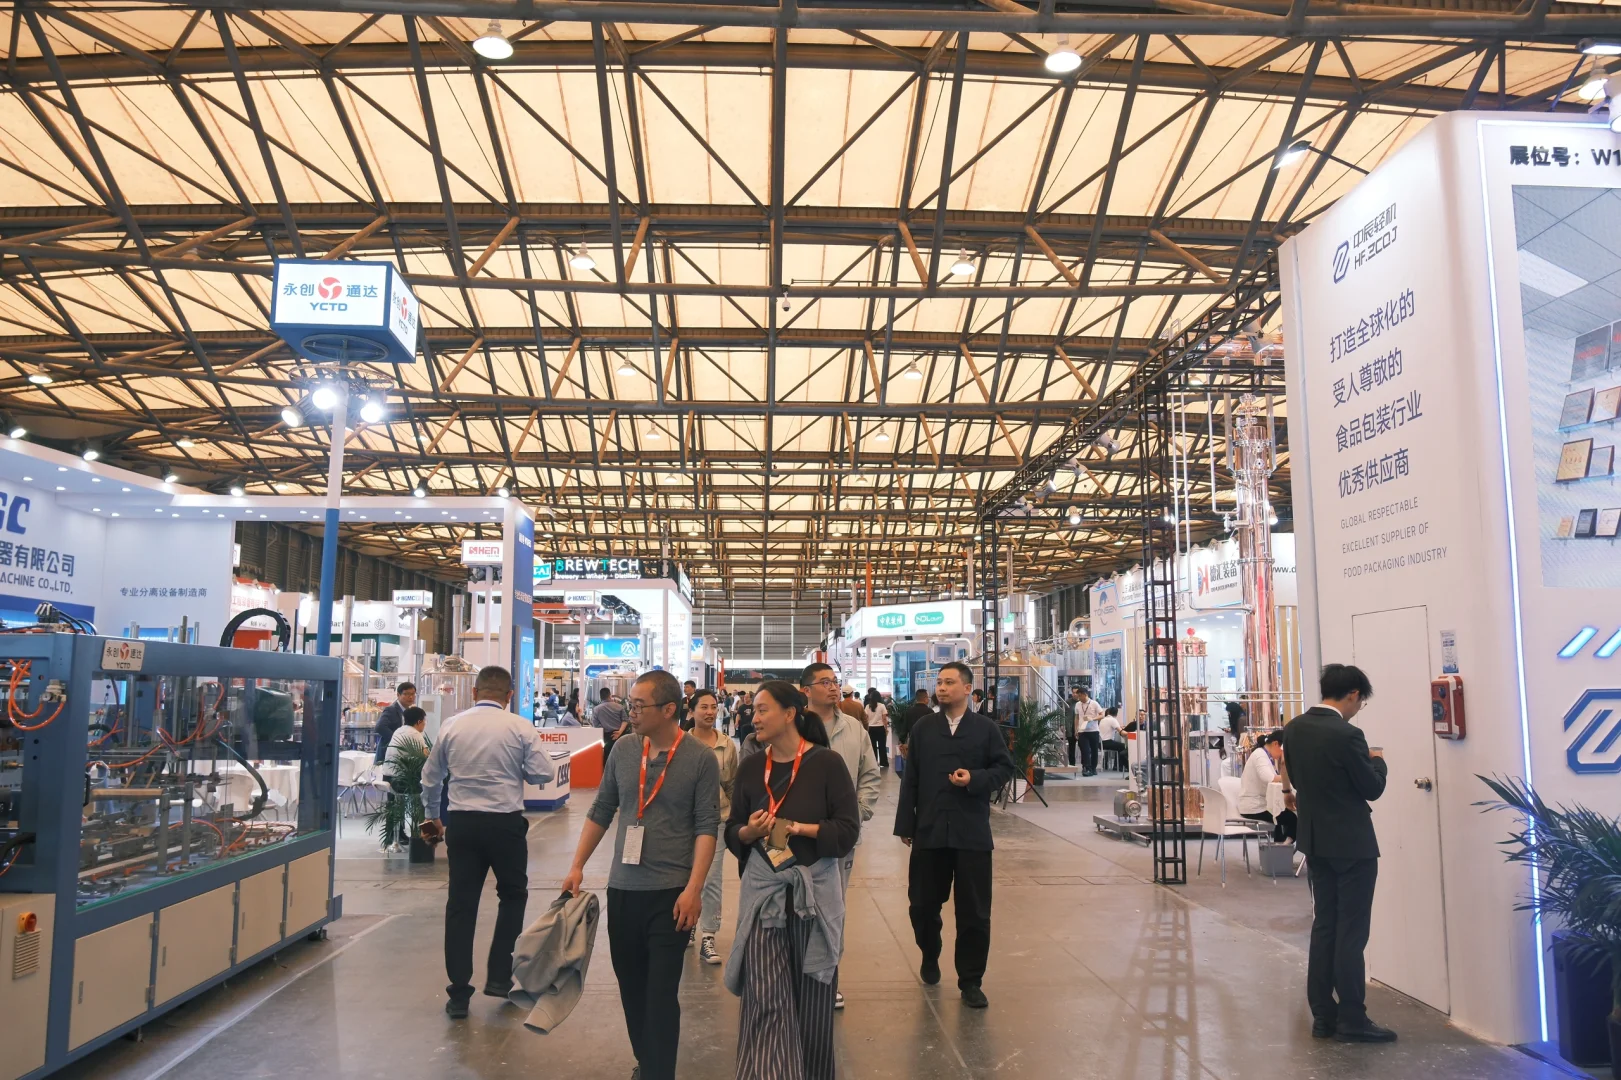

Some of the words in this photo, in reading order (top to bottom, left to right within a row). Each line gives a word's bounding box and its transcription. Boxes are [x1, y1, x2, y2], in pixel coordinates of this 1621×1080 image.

[1354, 203, 1397, 249] 中辰轻机
[309, 302, 348, 311] YCTD
[1330, 288, 1414, 363] 打造全球化的
[1333, 347, 1403, 408] 受人尊敬的
[1336, 389, 1423, 453] 食品包装行业
[1338, 447, 1409, 498] 优秀供应商
[1341, 513, 1366, 529] GLOBAL
[1368, 497, 1419, 521] RESPECTABLE
[1342, 535, 1379, 553] EXCELLENT
[1381, 525, 1416, 544] SUPPLIER
[1418, 522, 1429, 535] OF
[555, 559, 639, 571] BREWTECH
[1344, 565, 1362, 578] FOOD
[1364, 555, 1405, 574] PACKAGING
[1407, 547, 1447, 565] INDUSTRY
[120, 587, 208, 598] 专业分离设备制造商
